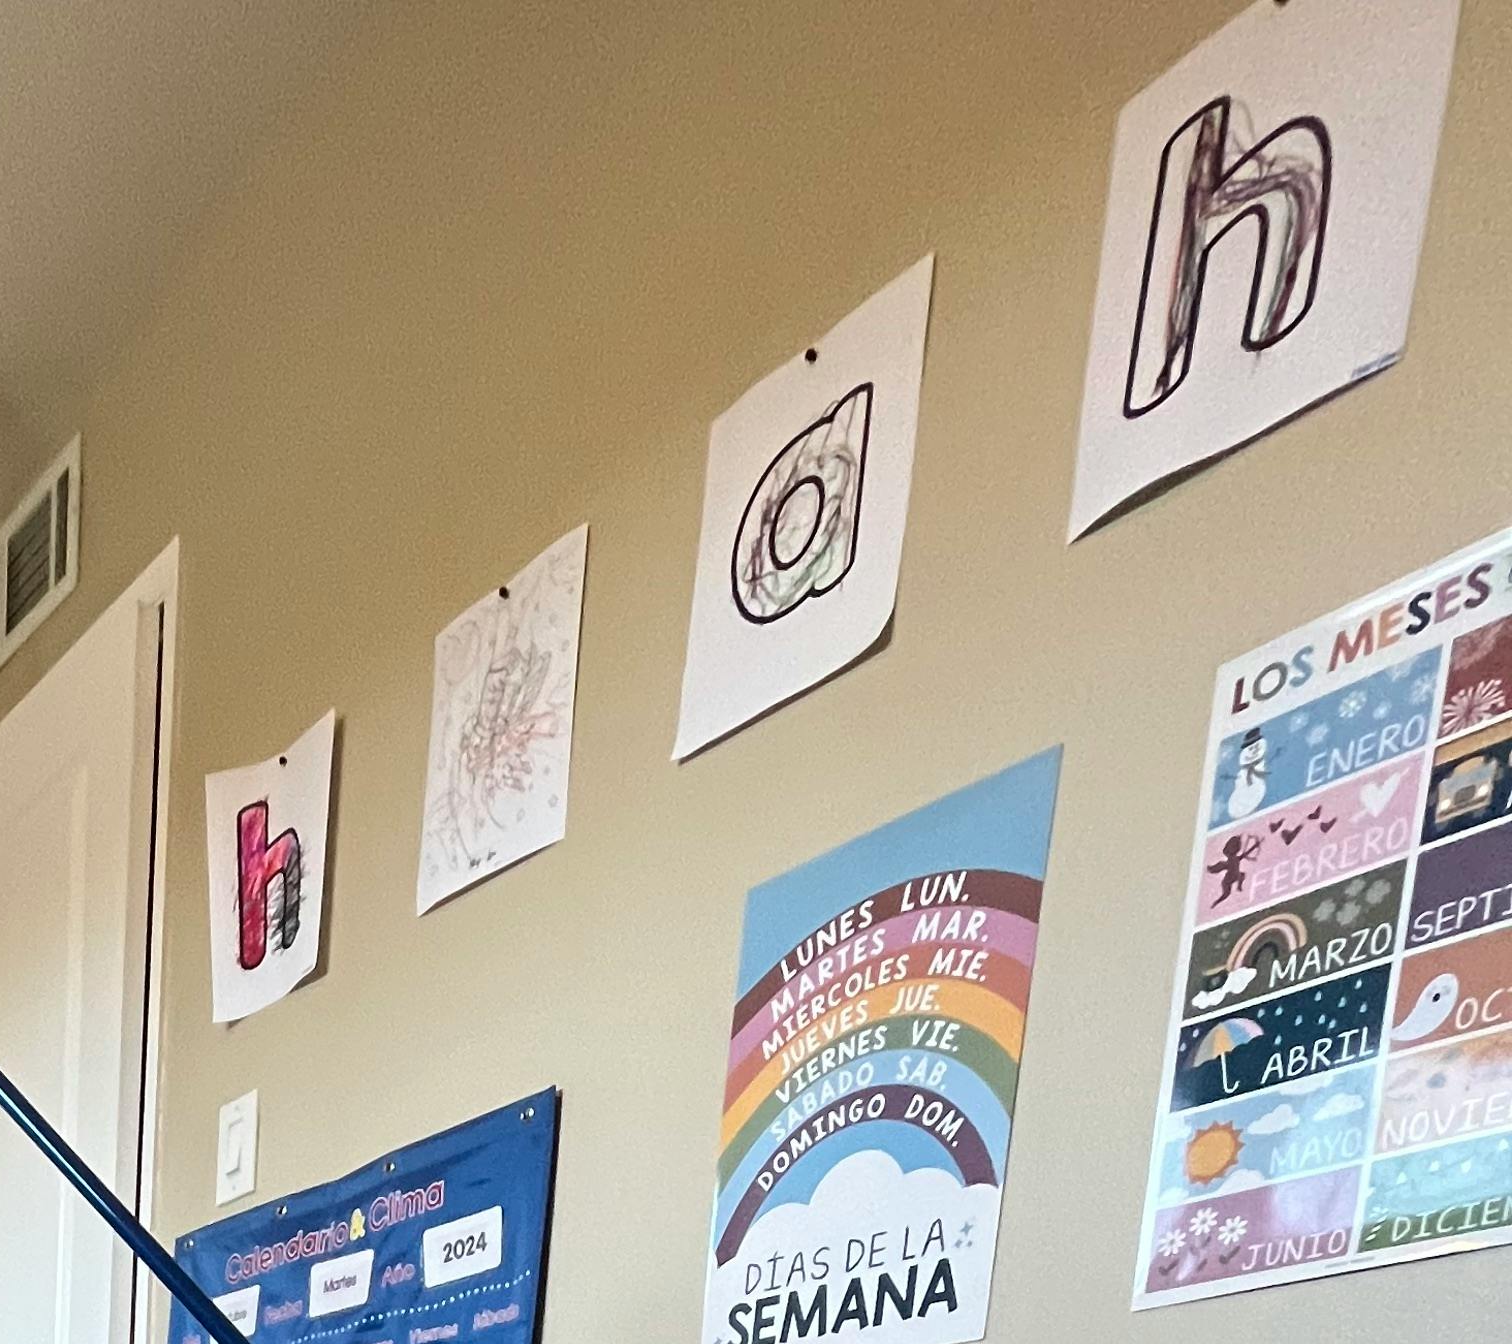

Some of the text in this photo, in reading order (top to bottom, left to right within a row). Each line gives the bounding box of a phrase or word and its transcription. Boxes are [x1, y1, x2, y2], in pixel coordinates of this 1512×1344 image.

[1123, 94, 1331, 420] h
[731, 382, 874, 625] a
[1231, 562, 1493, 715] LOS MESES
[1305, 713, 1426, 788] ENERO
[236, 800, 302, 970] h
[1249, 816, 1410, 902] FEBRERO
[770, 910, 989, 1023] MARTES MAR.
[780, 871, 970, 983] LUNES LUN.
[1269, 922, 1393, 989] MARZO
[761, 947, 989, 1061] MIERCOLES MIE.
[781, 984, 941, 1075] JUEVES JUE.
[770, 1055, 948, 1143] SABADO SAB.
[775, 1019, 961, 1103] VIERNES VIE.
[1260, 1026, 1374, 1084] ABRIL
[757, 1093, 965, 1192] DOMINGO DOM.
[1269, 1129, 1363, 1176] MAYO
[1382, 1091, 1512, 1151] NOVIE
[224, 1220, 350, 1284] Calendario
[368, 1179, 446, 1232] Clima
[322, 1273, 358, 1294] Martes
[442, 1232, 488, 1264] 2024
[845, 1231, 888, 1272] DE
[902, 1218, 945, 1261] LA
[1241, 1230, 1347, 1272] JUNIO
